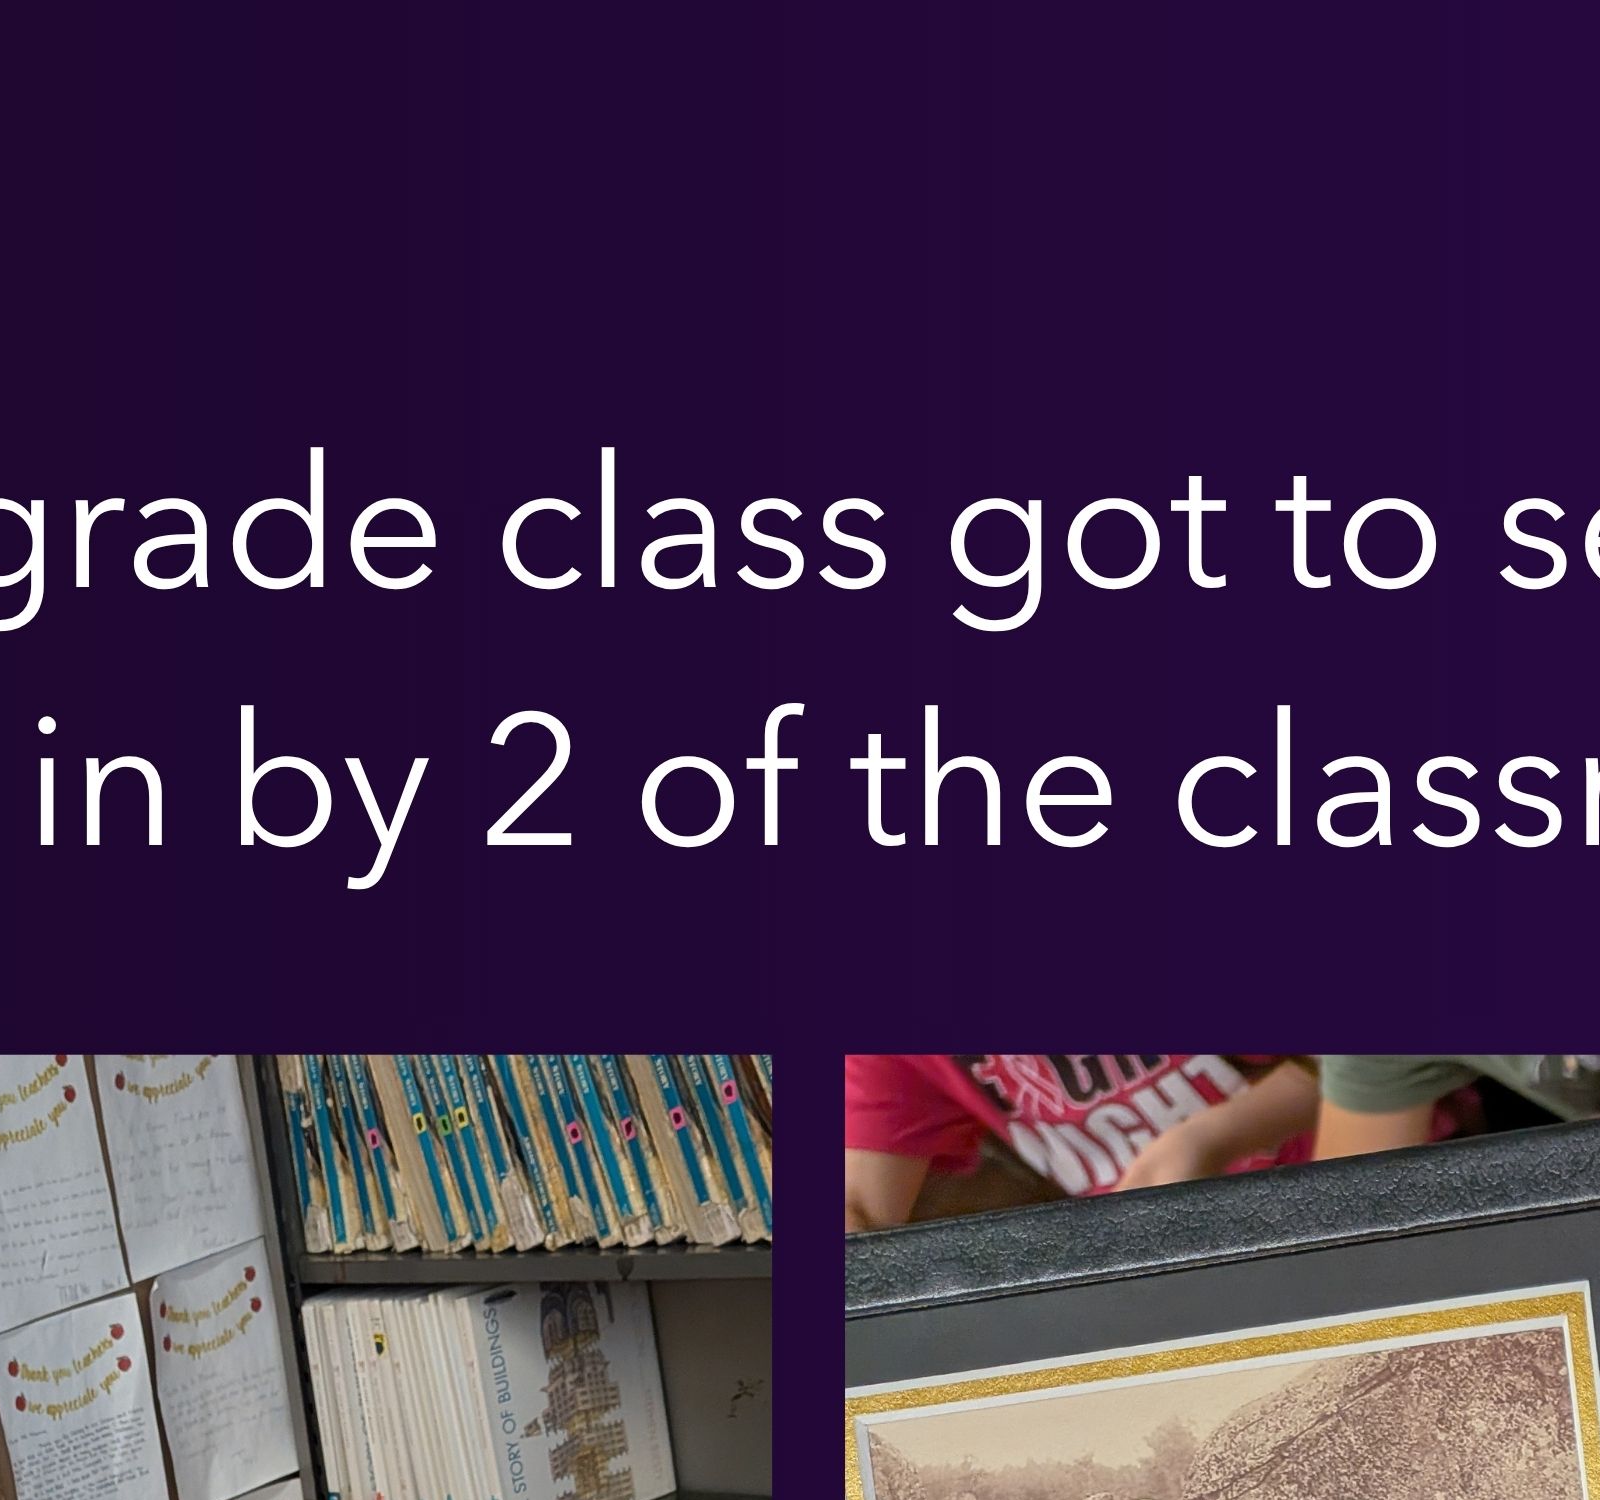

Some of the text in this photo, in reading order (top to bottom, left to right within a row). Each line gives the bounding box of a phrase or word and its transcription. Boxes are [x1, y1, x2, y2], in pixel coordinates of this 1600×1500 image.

[483, 1307, 512, 1404] BUILDINGS
[500, 1410, 517, 1435] OF
[507, 1441, 527, 1494] STORY
